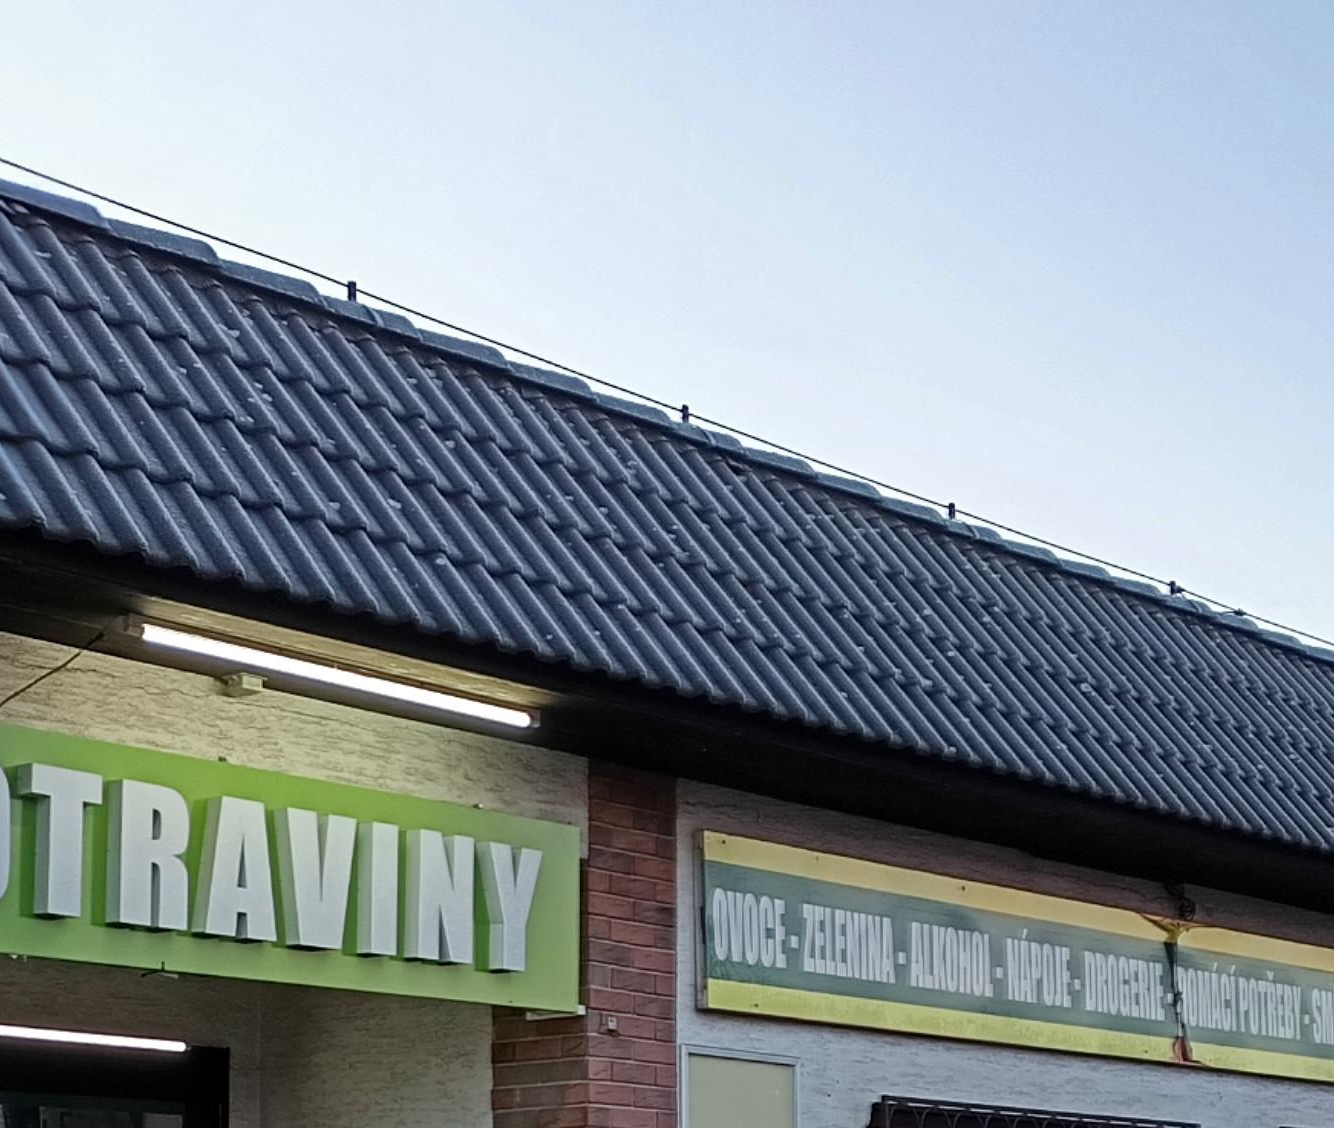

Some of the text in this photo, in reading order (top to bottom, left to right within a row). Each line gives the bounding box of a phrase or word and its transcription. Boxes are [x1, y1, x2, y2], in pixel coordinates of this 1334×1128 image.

[712, 887, 1166, 1022] OVOCE ZELENINA ALKOHOL NÁPOJE DROGERIE
[1238, 971, 1302, 1040] POTŘEBY
